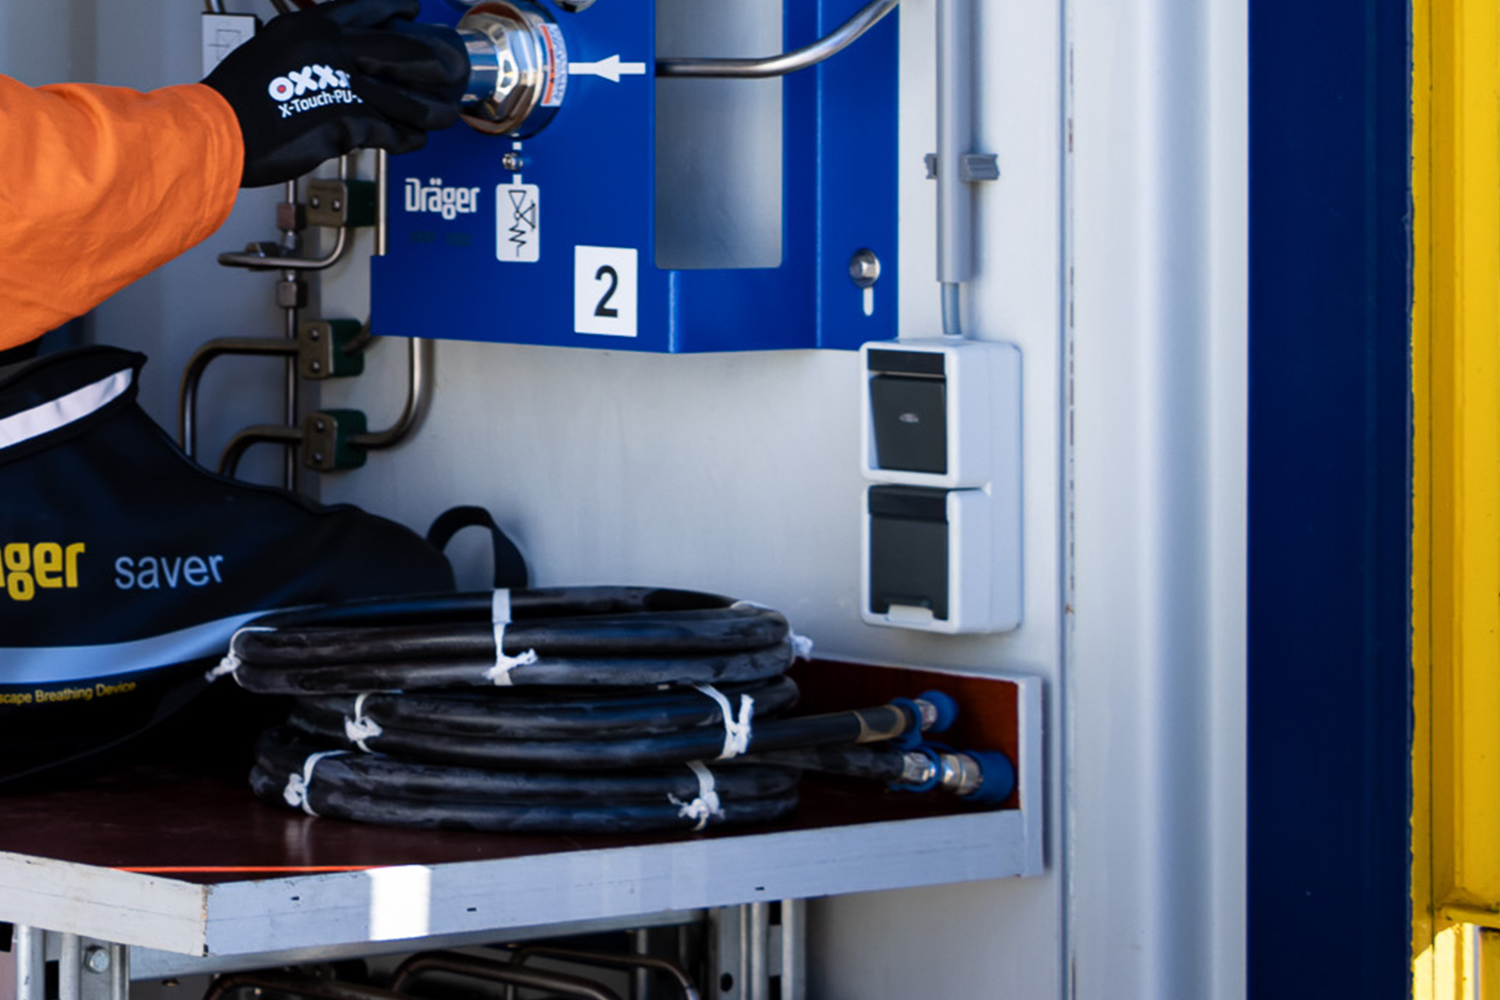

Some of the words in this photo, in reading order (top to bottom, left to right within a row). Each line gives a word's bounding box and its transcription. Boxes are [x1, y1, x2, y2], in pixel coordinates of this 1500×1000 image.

[278, 89, 363, 118] X-Touch-PU-
[405, 177, 480, 220] Dräger
[594, 264, 619, 318] 2
[114, 551, 224, 590] saver
[35, 686, 93, 704] Breathing
[95, 680, 137, 697] Device
